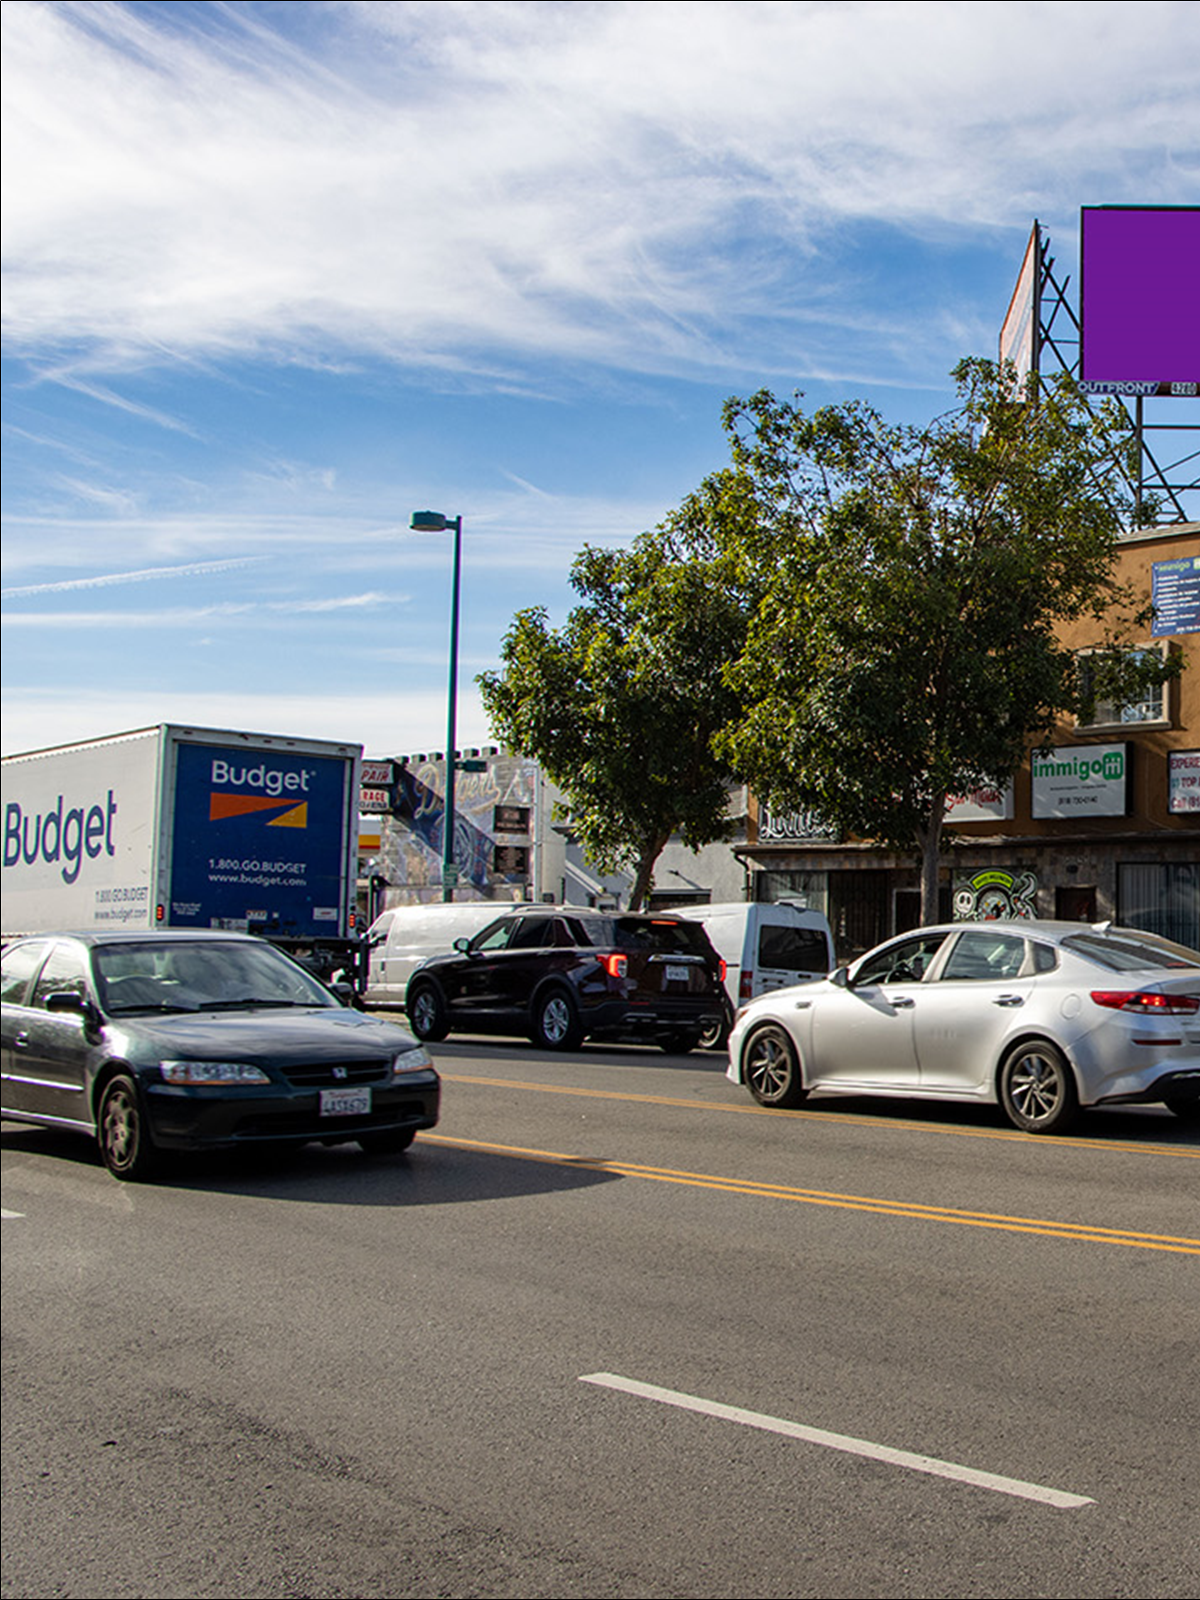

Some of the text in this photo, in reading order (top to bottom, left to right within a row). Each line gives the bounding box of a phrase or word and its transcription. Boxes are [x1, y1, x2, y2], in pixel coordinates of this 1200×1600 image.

[1077, 381, 1154, 394] OUTFRONT
[1033, 756, 1103, 781] immigo
[211, 760, 310, 796] Budget
[1181, 777, 1197, 788] TOP
[3, 789, 117, 885] Budget
[208, 859, 307, 874] 1.800.GO.BUDGET
[208, 873, 307, 888] www.budget.com
